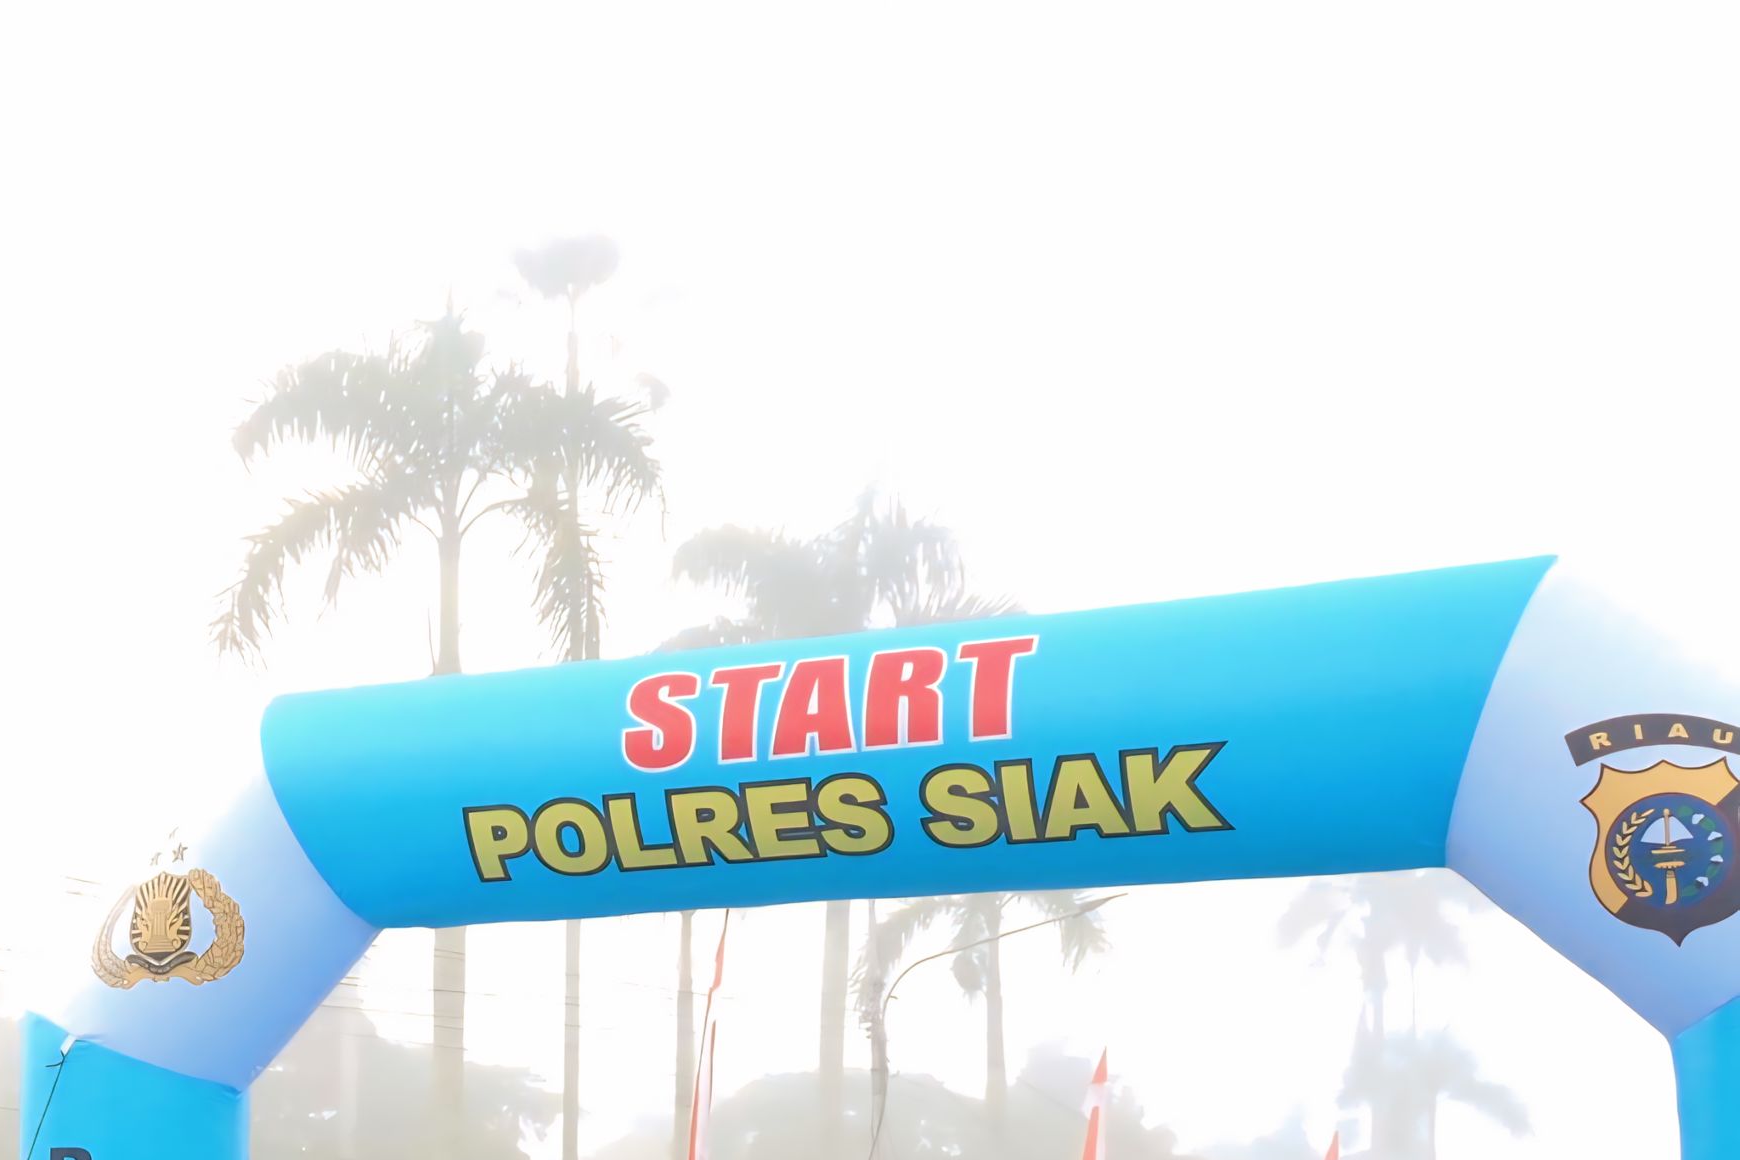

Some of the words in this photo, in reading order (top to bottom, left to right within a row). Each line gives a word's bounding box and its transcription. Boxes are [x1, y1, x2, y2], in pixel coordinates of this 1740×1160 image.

[621, 634, 1040, 773] START
[1589, 723, 1733, 750] RIAU
[462, 774, 894, 883] POLRES
[920, 740, 1236, 849] SIAK
